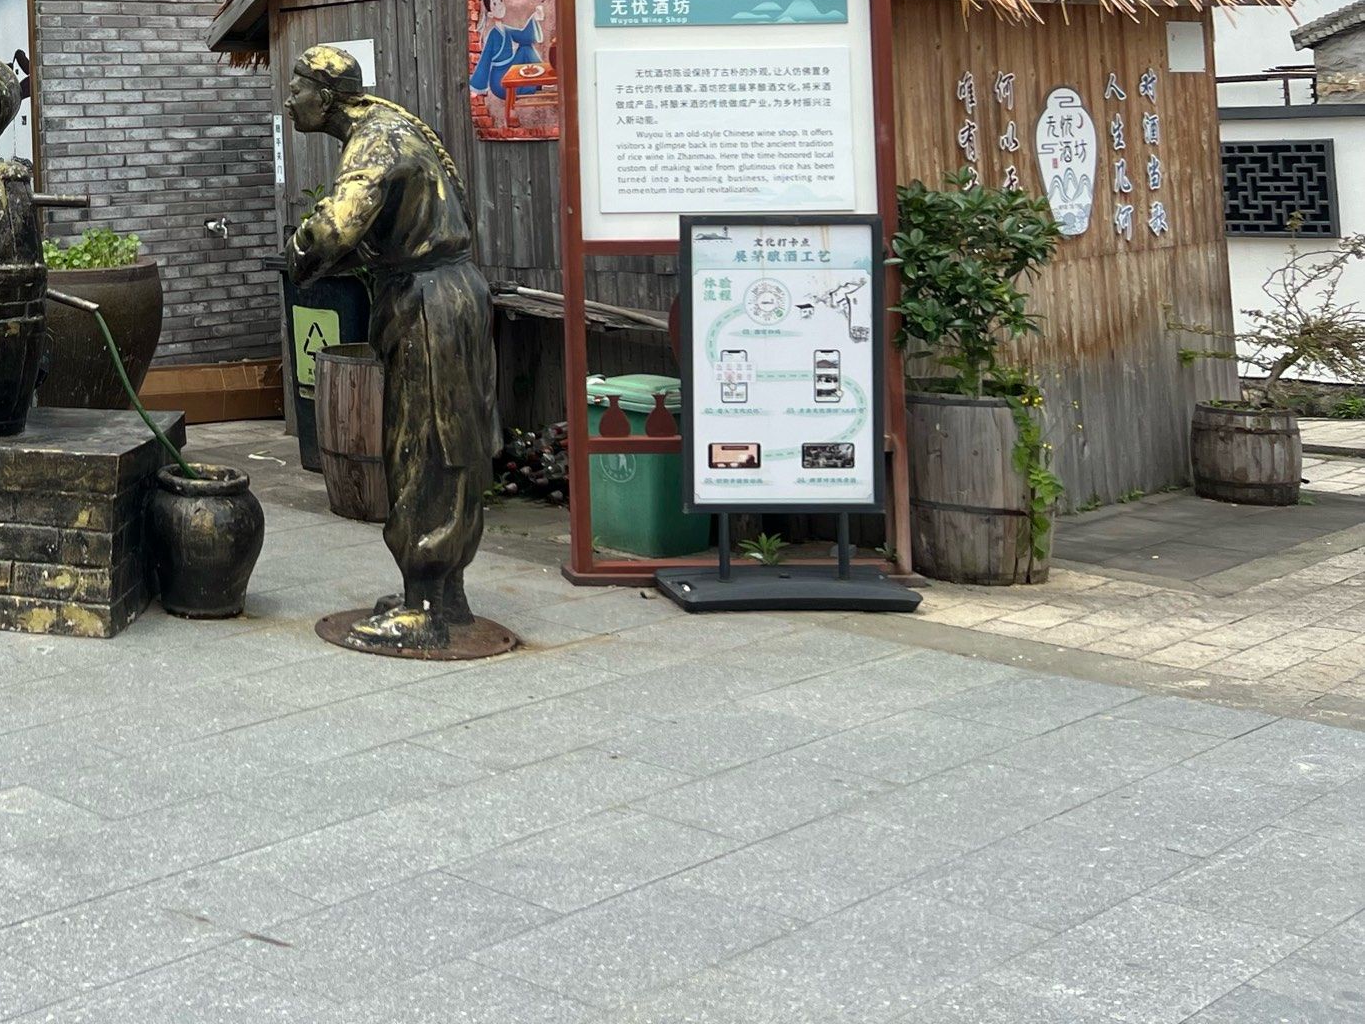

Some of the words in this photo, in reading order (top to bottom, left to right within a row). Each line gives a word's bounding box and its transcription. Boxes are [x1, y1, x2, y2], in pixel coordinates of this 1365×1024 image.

[610, 17, 639, 25] Wuyou
[665, 16, 688, 24] Shop
[1046, 115, 1075, 137] 无忧
[636, 131, 663, 139] Wuyou
[686, 130, 721, 138] old-style
[778, 129, 799, 138] shop.
[810, 128, 833, 136] offers
[655, 142, 686, 151] glimpse
[688, 141, 707, 149] back
[1059, 139, 1087, 163] 酒坊
[677, 152, 717, 160] Zhanmao.
[1104, 72, 1133, 241] 人生几何
[1139, 68, 1168, 236] 对酒当歌
[661, 164, 691, 173] making
[738, 163, 776, 172] glutinous
[684, 175, 723, 184] booming
[773, 174, 813, 183] injecting
[753, 237, 811, 247] 文化打卡点
[732, 250, 831, 263] 展茅酿酒工艺
[703, 277, 732, 289] 体验
[703, 290, 732, 301] 流程
